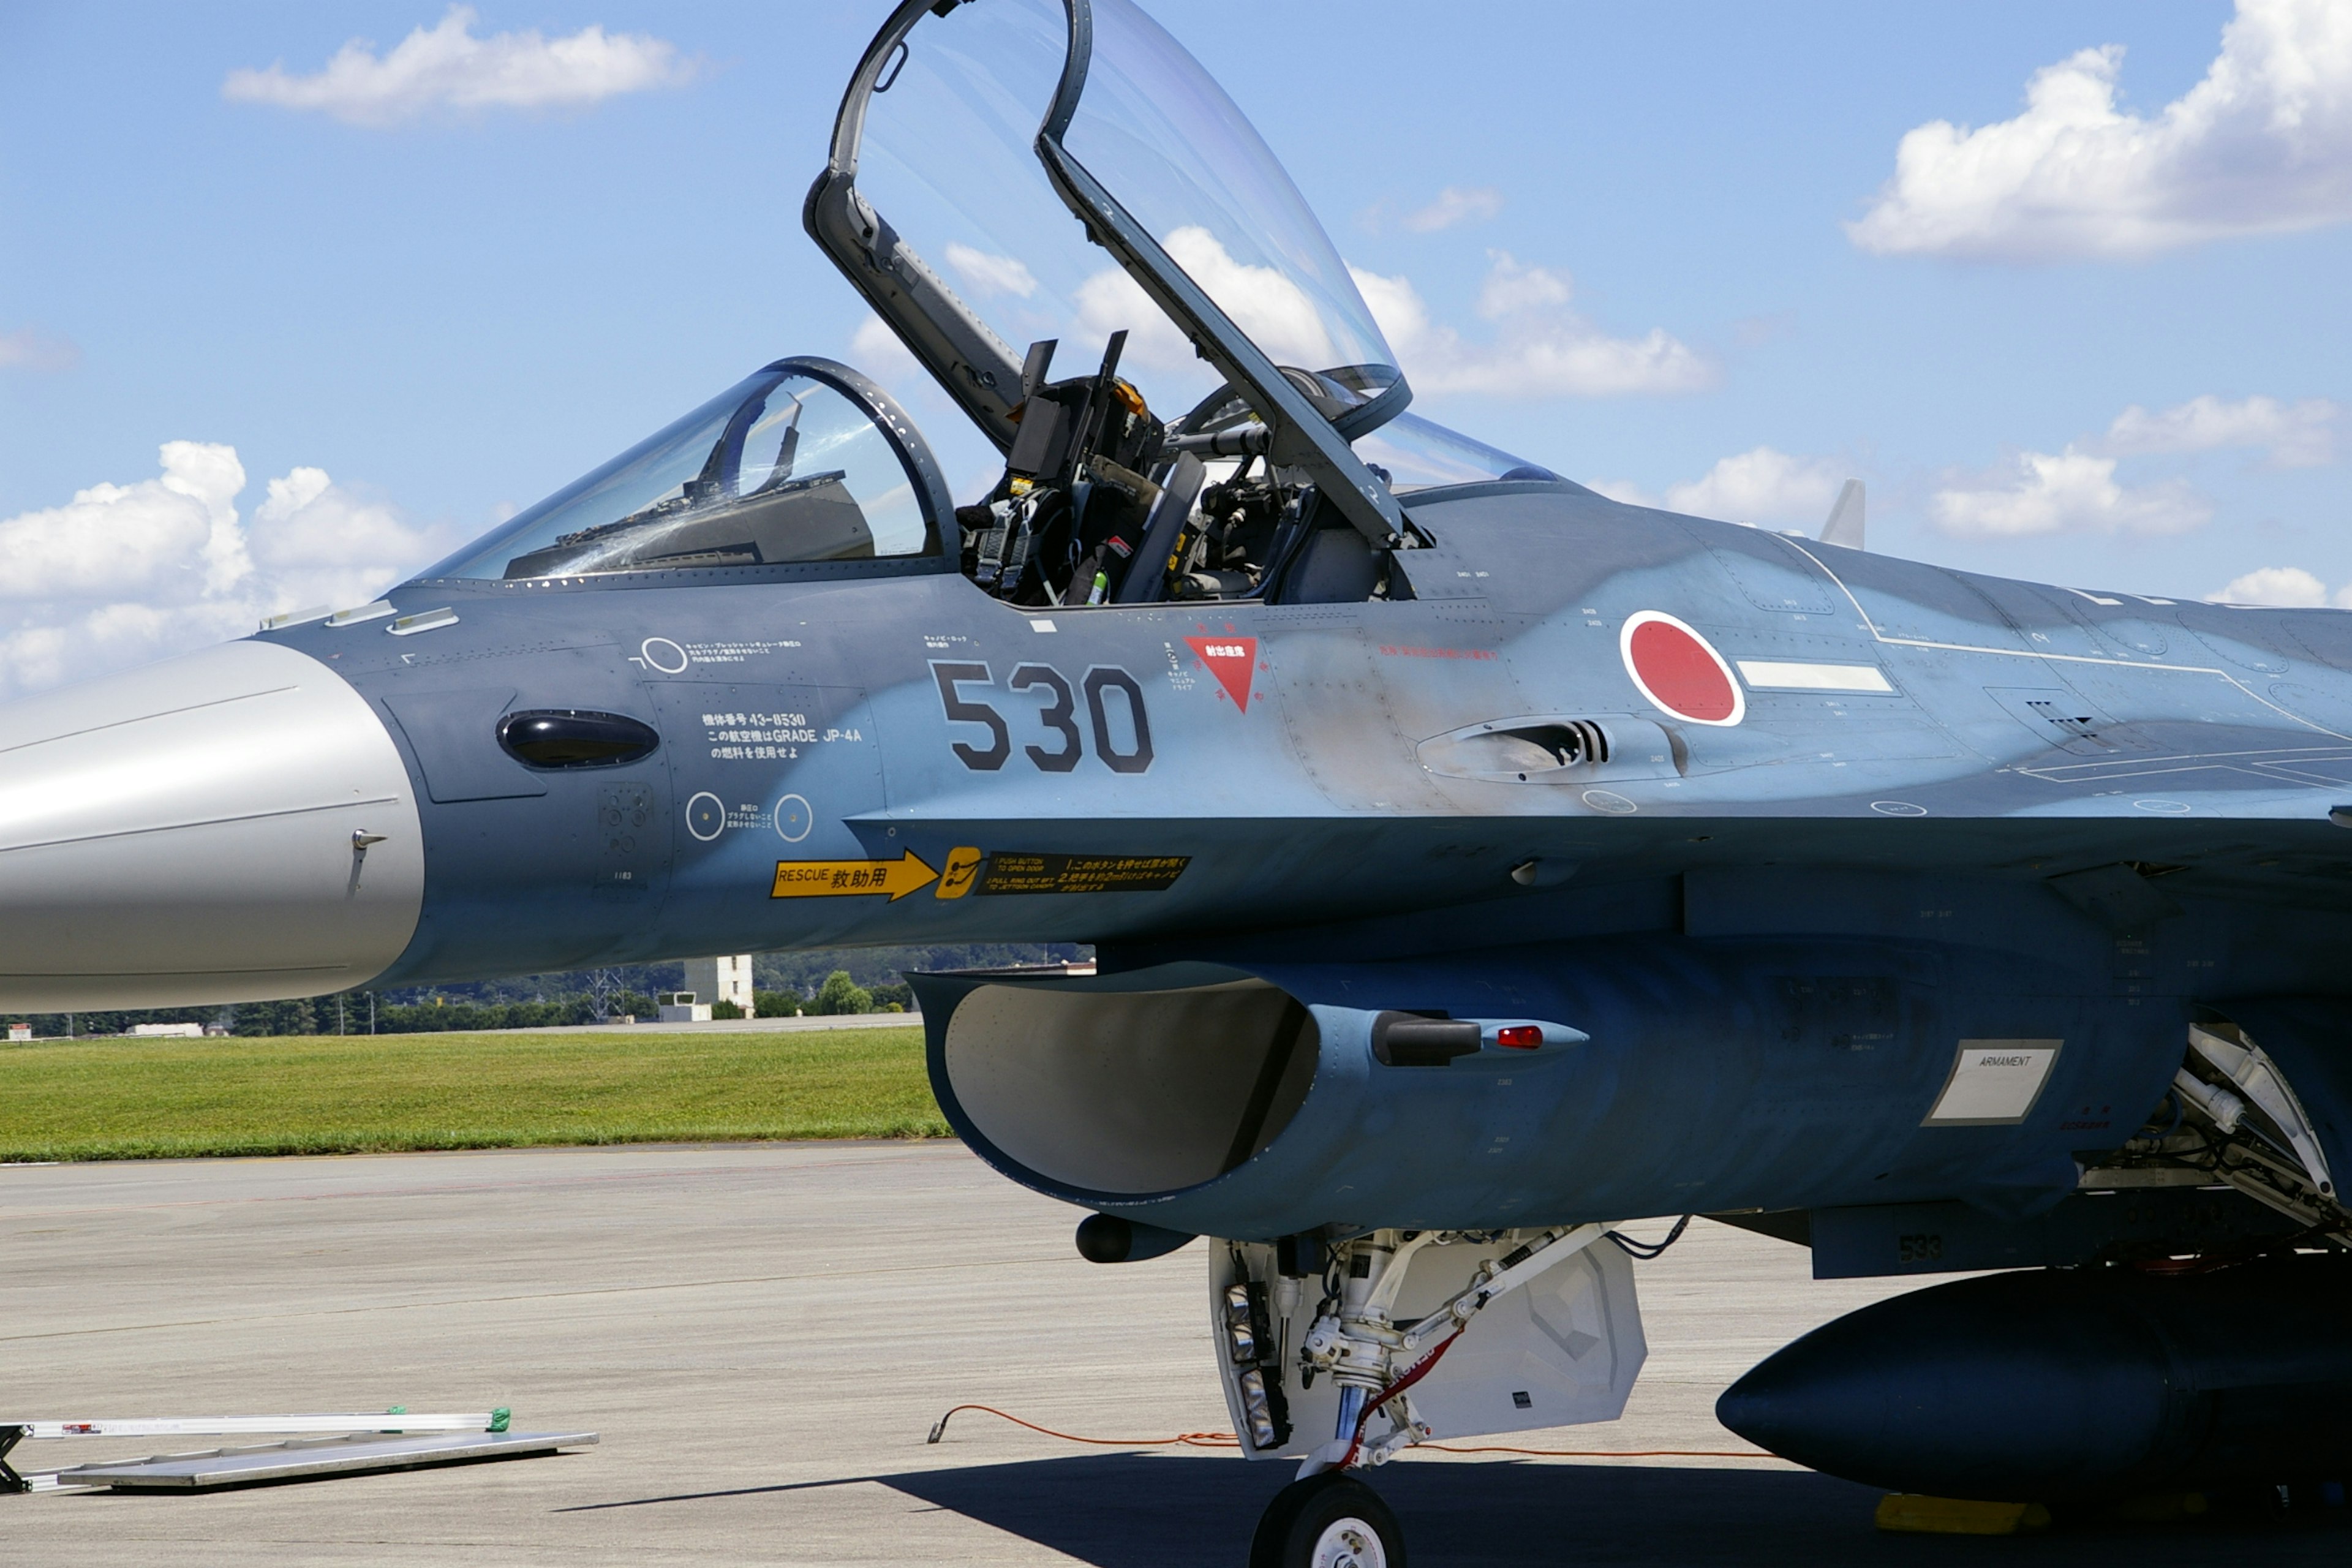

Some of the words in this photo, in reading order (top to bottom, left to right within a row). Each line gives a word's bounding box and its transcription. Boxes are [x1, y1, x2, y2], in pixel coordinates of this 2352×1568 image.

[702, 714, 747, 726] 機体番号
[928, 659, 1155, 774] 530
[823, 729, 862, 742] JP-4A
[711, 747, 798, 759] の燃料を使用せよ
[778, 868, 830, 882] RESCUE
[831, 868, 888, 889] 救助用
[1979, 1055, 2032, 1066] ARMAMENT
[1900, 1234, 1942, 1263] 533
